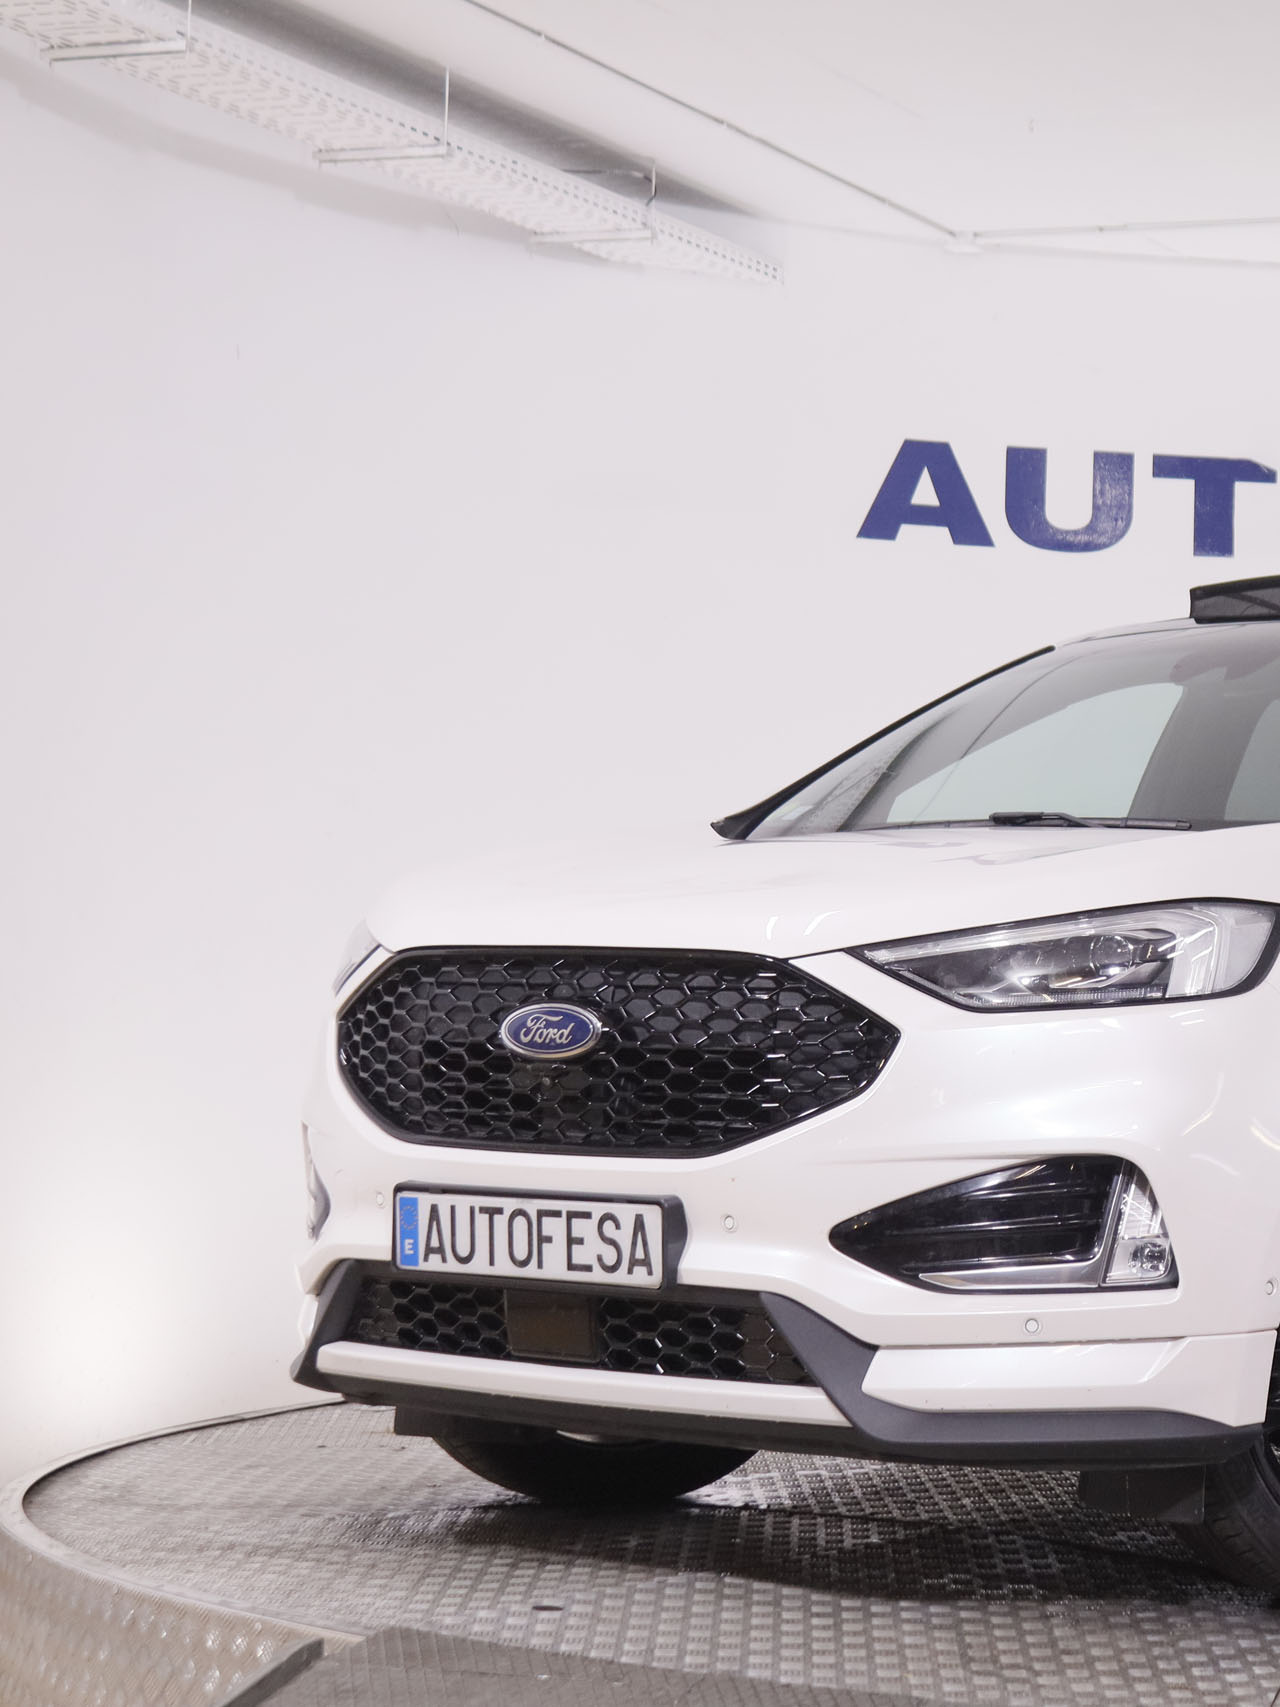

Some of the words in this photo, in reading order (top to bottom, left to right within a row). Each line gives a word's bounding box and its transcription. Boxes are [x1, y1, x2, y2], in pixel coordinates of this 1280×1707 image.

[520, 1013, 576, 1044] Ford
[404, 1238, 415, 1255] E
[422, 1203, 655, 1277] AUTOFESA
